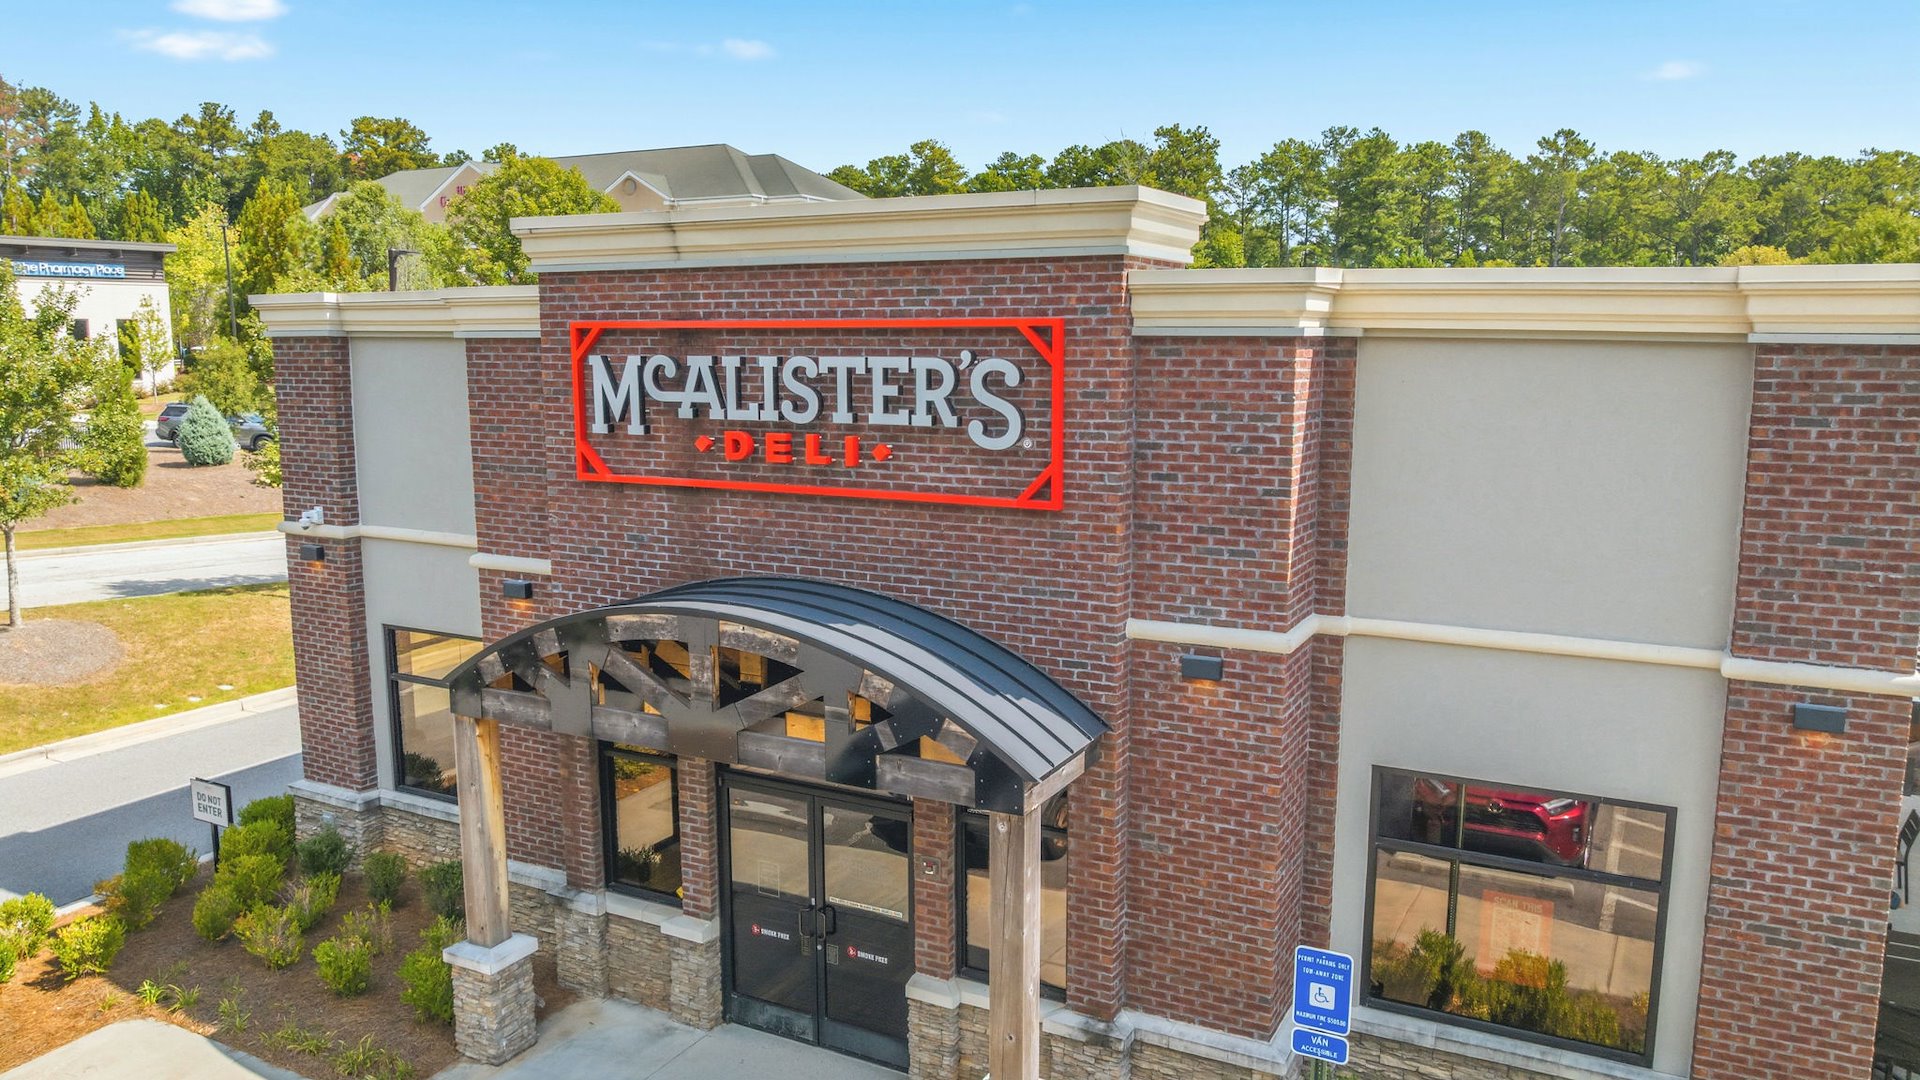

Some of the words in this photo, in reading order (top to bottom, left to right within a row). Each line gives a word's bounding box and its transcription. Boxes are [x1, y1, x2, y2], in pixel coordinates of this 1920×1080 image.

[39, 262, 95, 277] Pharmacy
[96, 263, 123, 274] Place
[723, 430, 861, 467] DELI
[196, 791, 207, 802] DO
[207, 794, 221, 807] NOT
[197, 802, 223, 818] ENTER
[1298, 954, 1315, 963] PERMIT
[1316, 957, 1336, 968] PARKING
[1338, 962, 1350, 971] ONLY
[1331, 973, 1344, 982] ZONE
[1317, 1014, 1327, 1023] FINE
[1310, 1035, 1329, 1048] VAN
[1301, 1044, 1338, 1060] ACCESSIBLE
